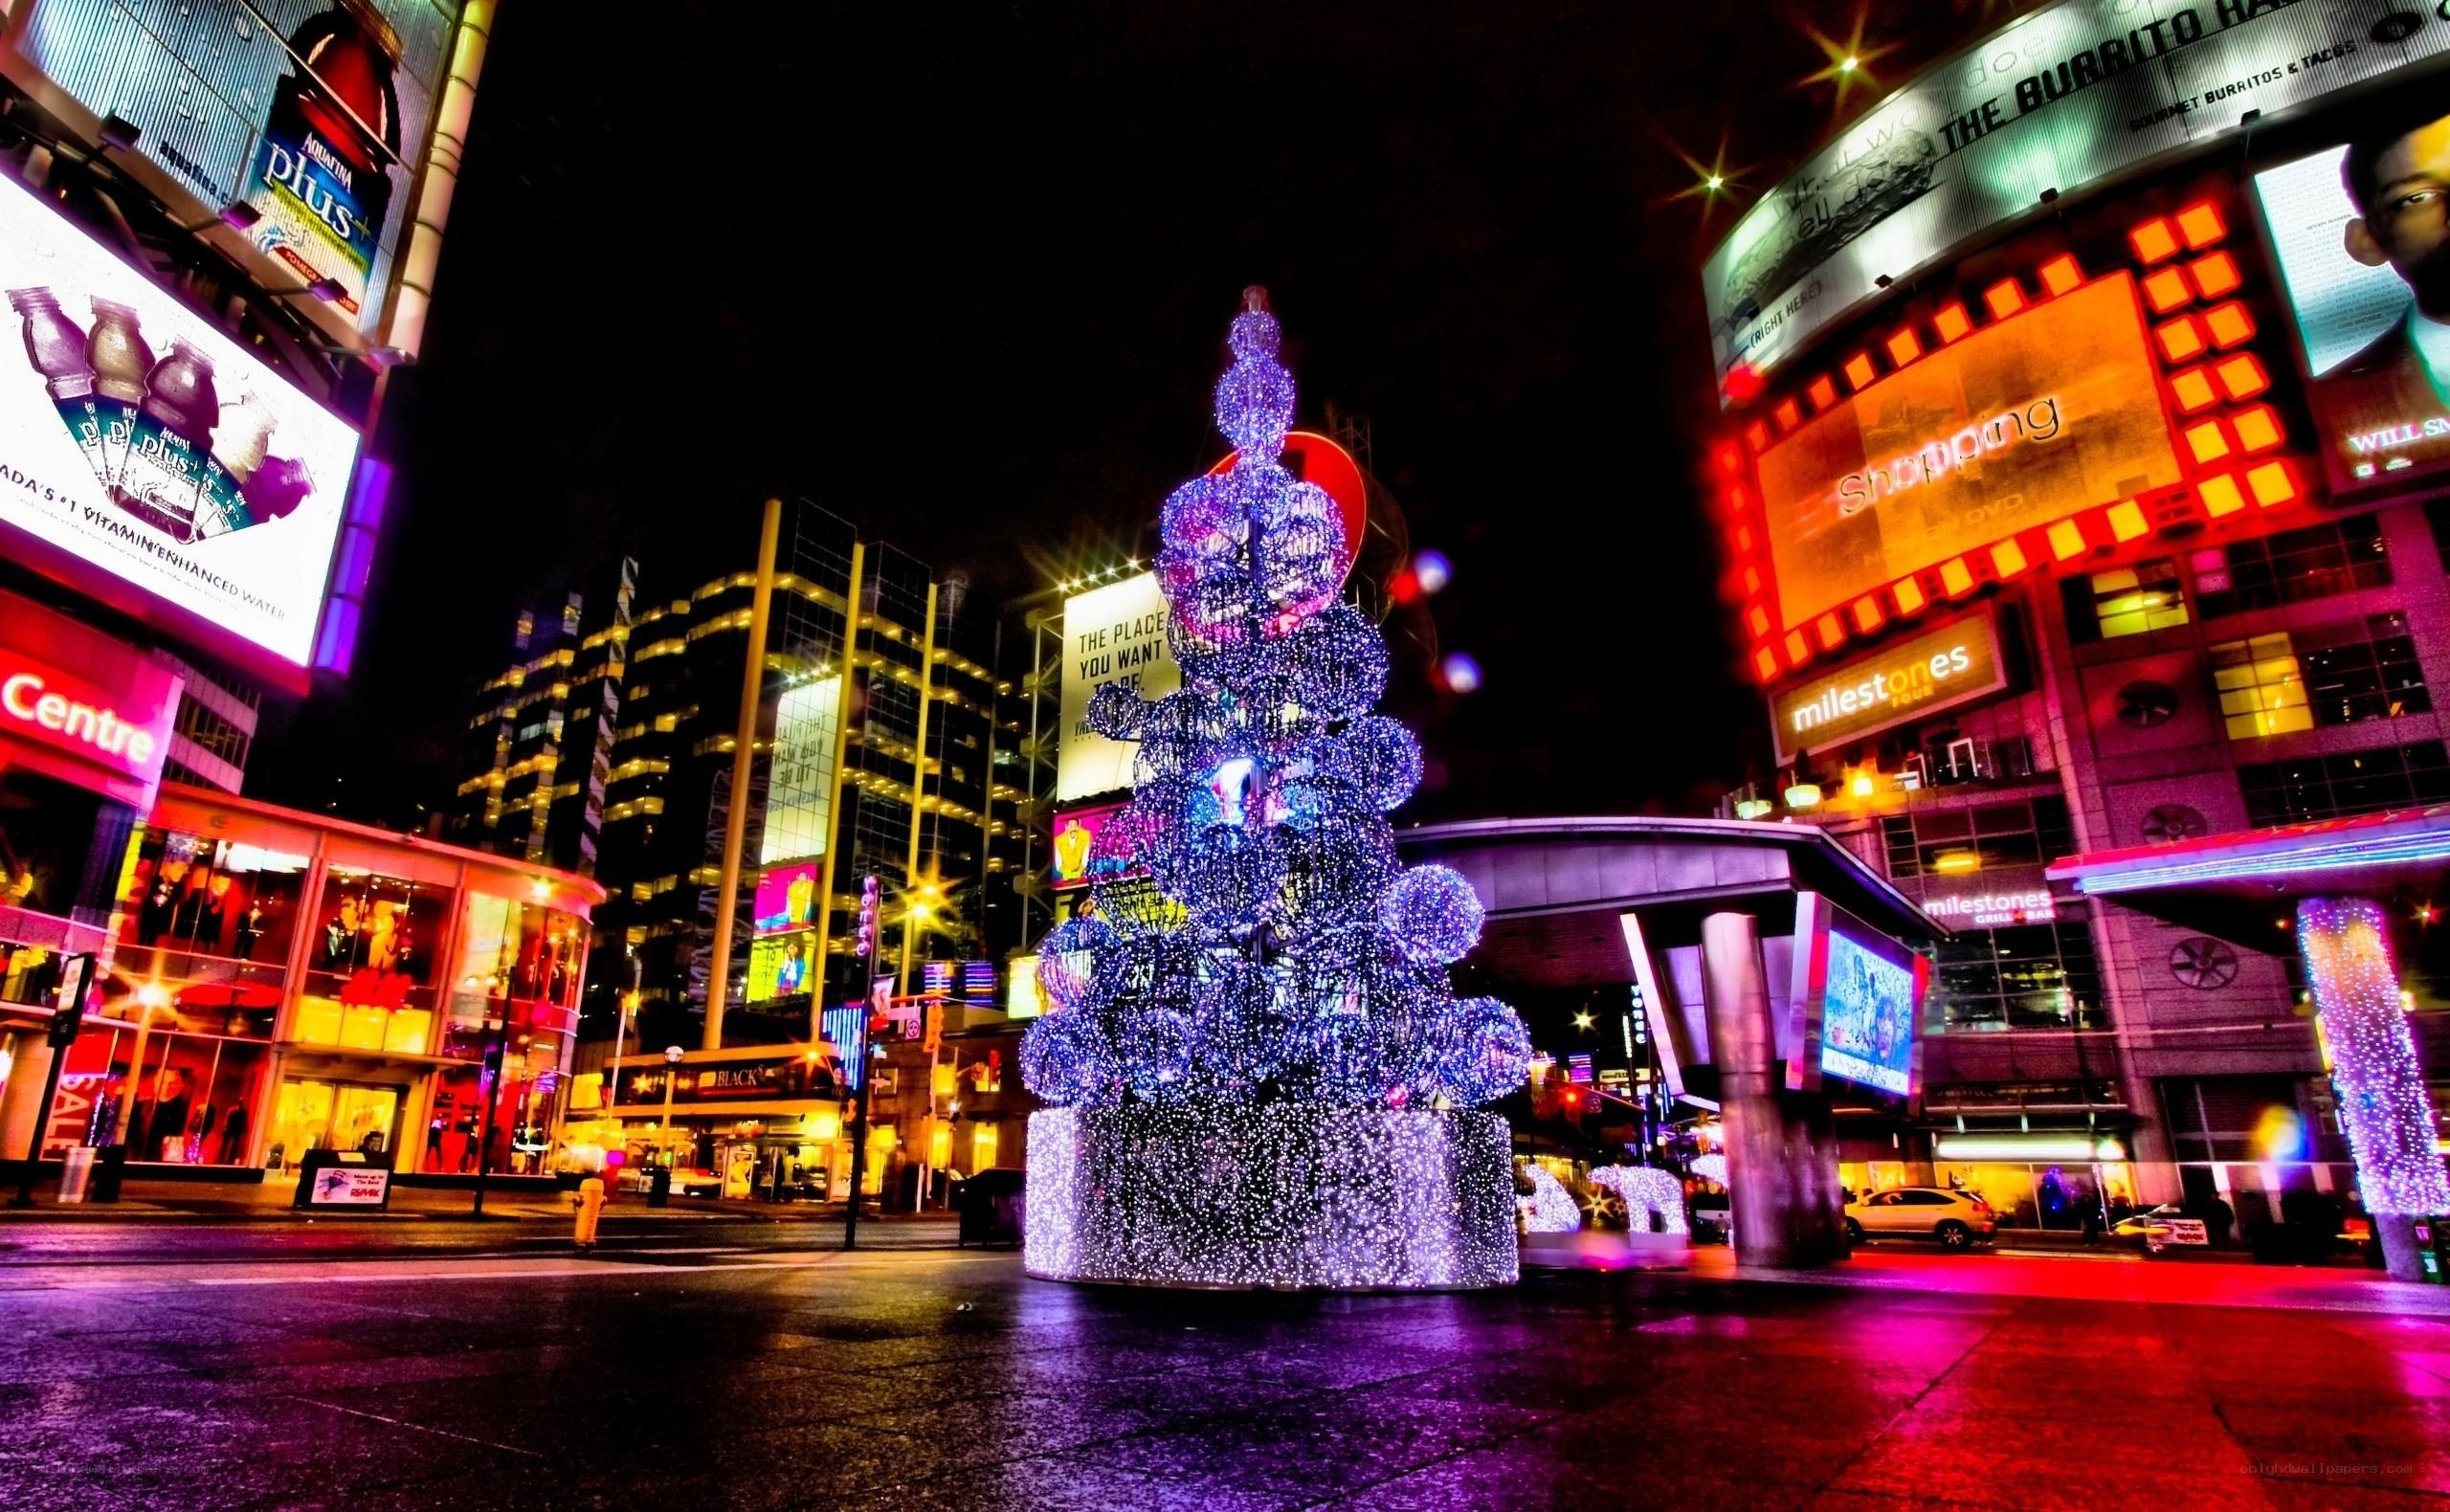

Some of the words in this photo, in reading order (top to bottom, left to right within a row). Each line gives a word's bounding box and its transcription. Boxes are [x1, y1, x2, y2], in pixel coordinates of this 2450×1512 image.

[1939, 97, 2007, 153] THE
[2015, 8, 2203, 115] BURRITO
[2129, 97, 2199, 133] GOURMET
[2204, 67, 2284, 104] BURRITOS
[2287, 62, 2300, 75] &
[2303, 39, 2358, 69] TACOS
[301, 131, 352, 194] AQUAFINA
[1749, 309, 1785, 348] (RIGHT
[1785, 279, 1822, 318] HERE)
[1839, 397, 2060, 514] Shopping
[2349, 424, 2423, 452] WILL
[242, 589, 286, 621] WATER
[1079, 628, 1107, 655] THE
[1113, 611, 1165, 644] PLACE
[1080, 654, 1110, 680] YOU
[1117, 639, 1163, 670] WANT
[1793, 645, 1971, 733] milestones
[1, 673, 155, 764] Centre
[1924, 891, 2055, 917] milestones
[1974, 913, 2015, 924] GRILL
[2027, 908, 2056, 921] BAR
[45, 1075, 96, 1151] SALE
